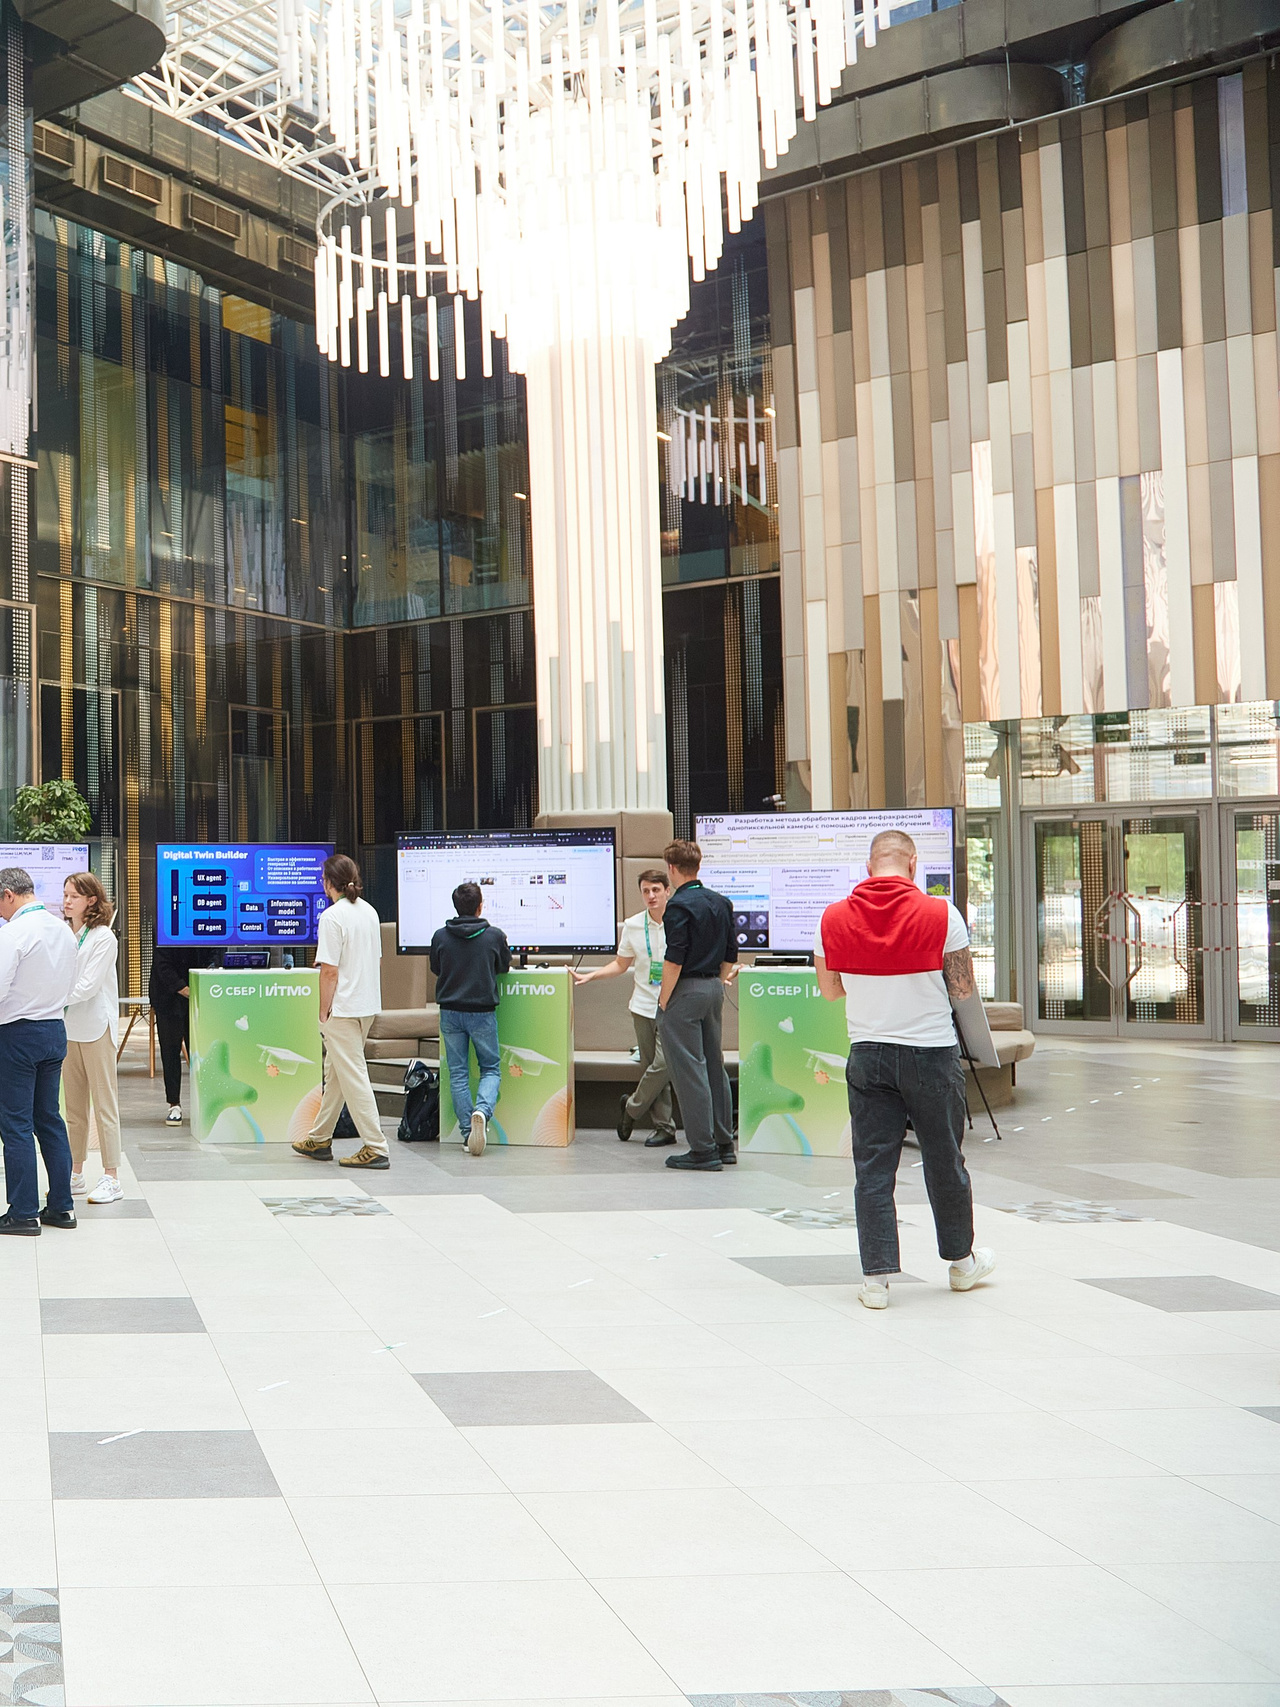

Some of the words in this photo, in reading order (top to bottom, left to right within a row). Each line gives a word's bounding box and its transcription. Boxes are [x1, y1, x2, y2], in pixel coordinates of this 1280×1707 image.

[163, 851, 192, 860] Digital
[226, 986, 256, 996] СБЕР
[768, 986, 801, 996] СБЕР
